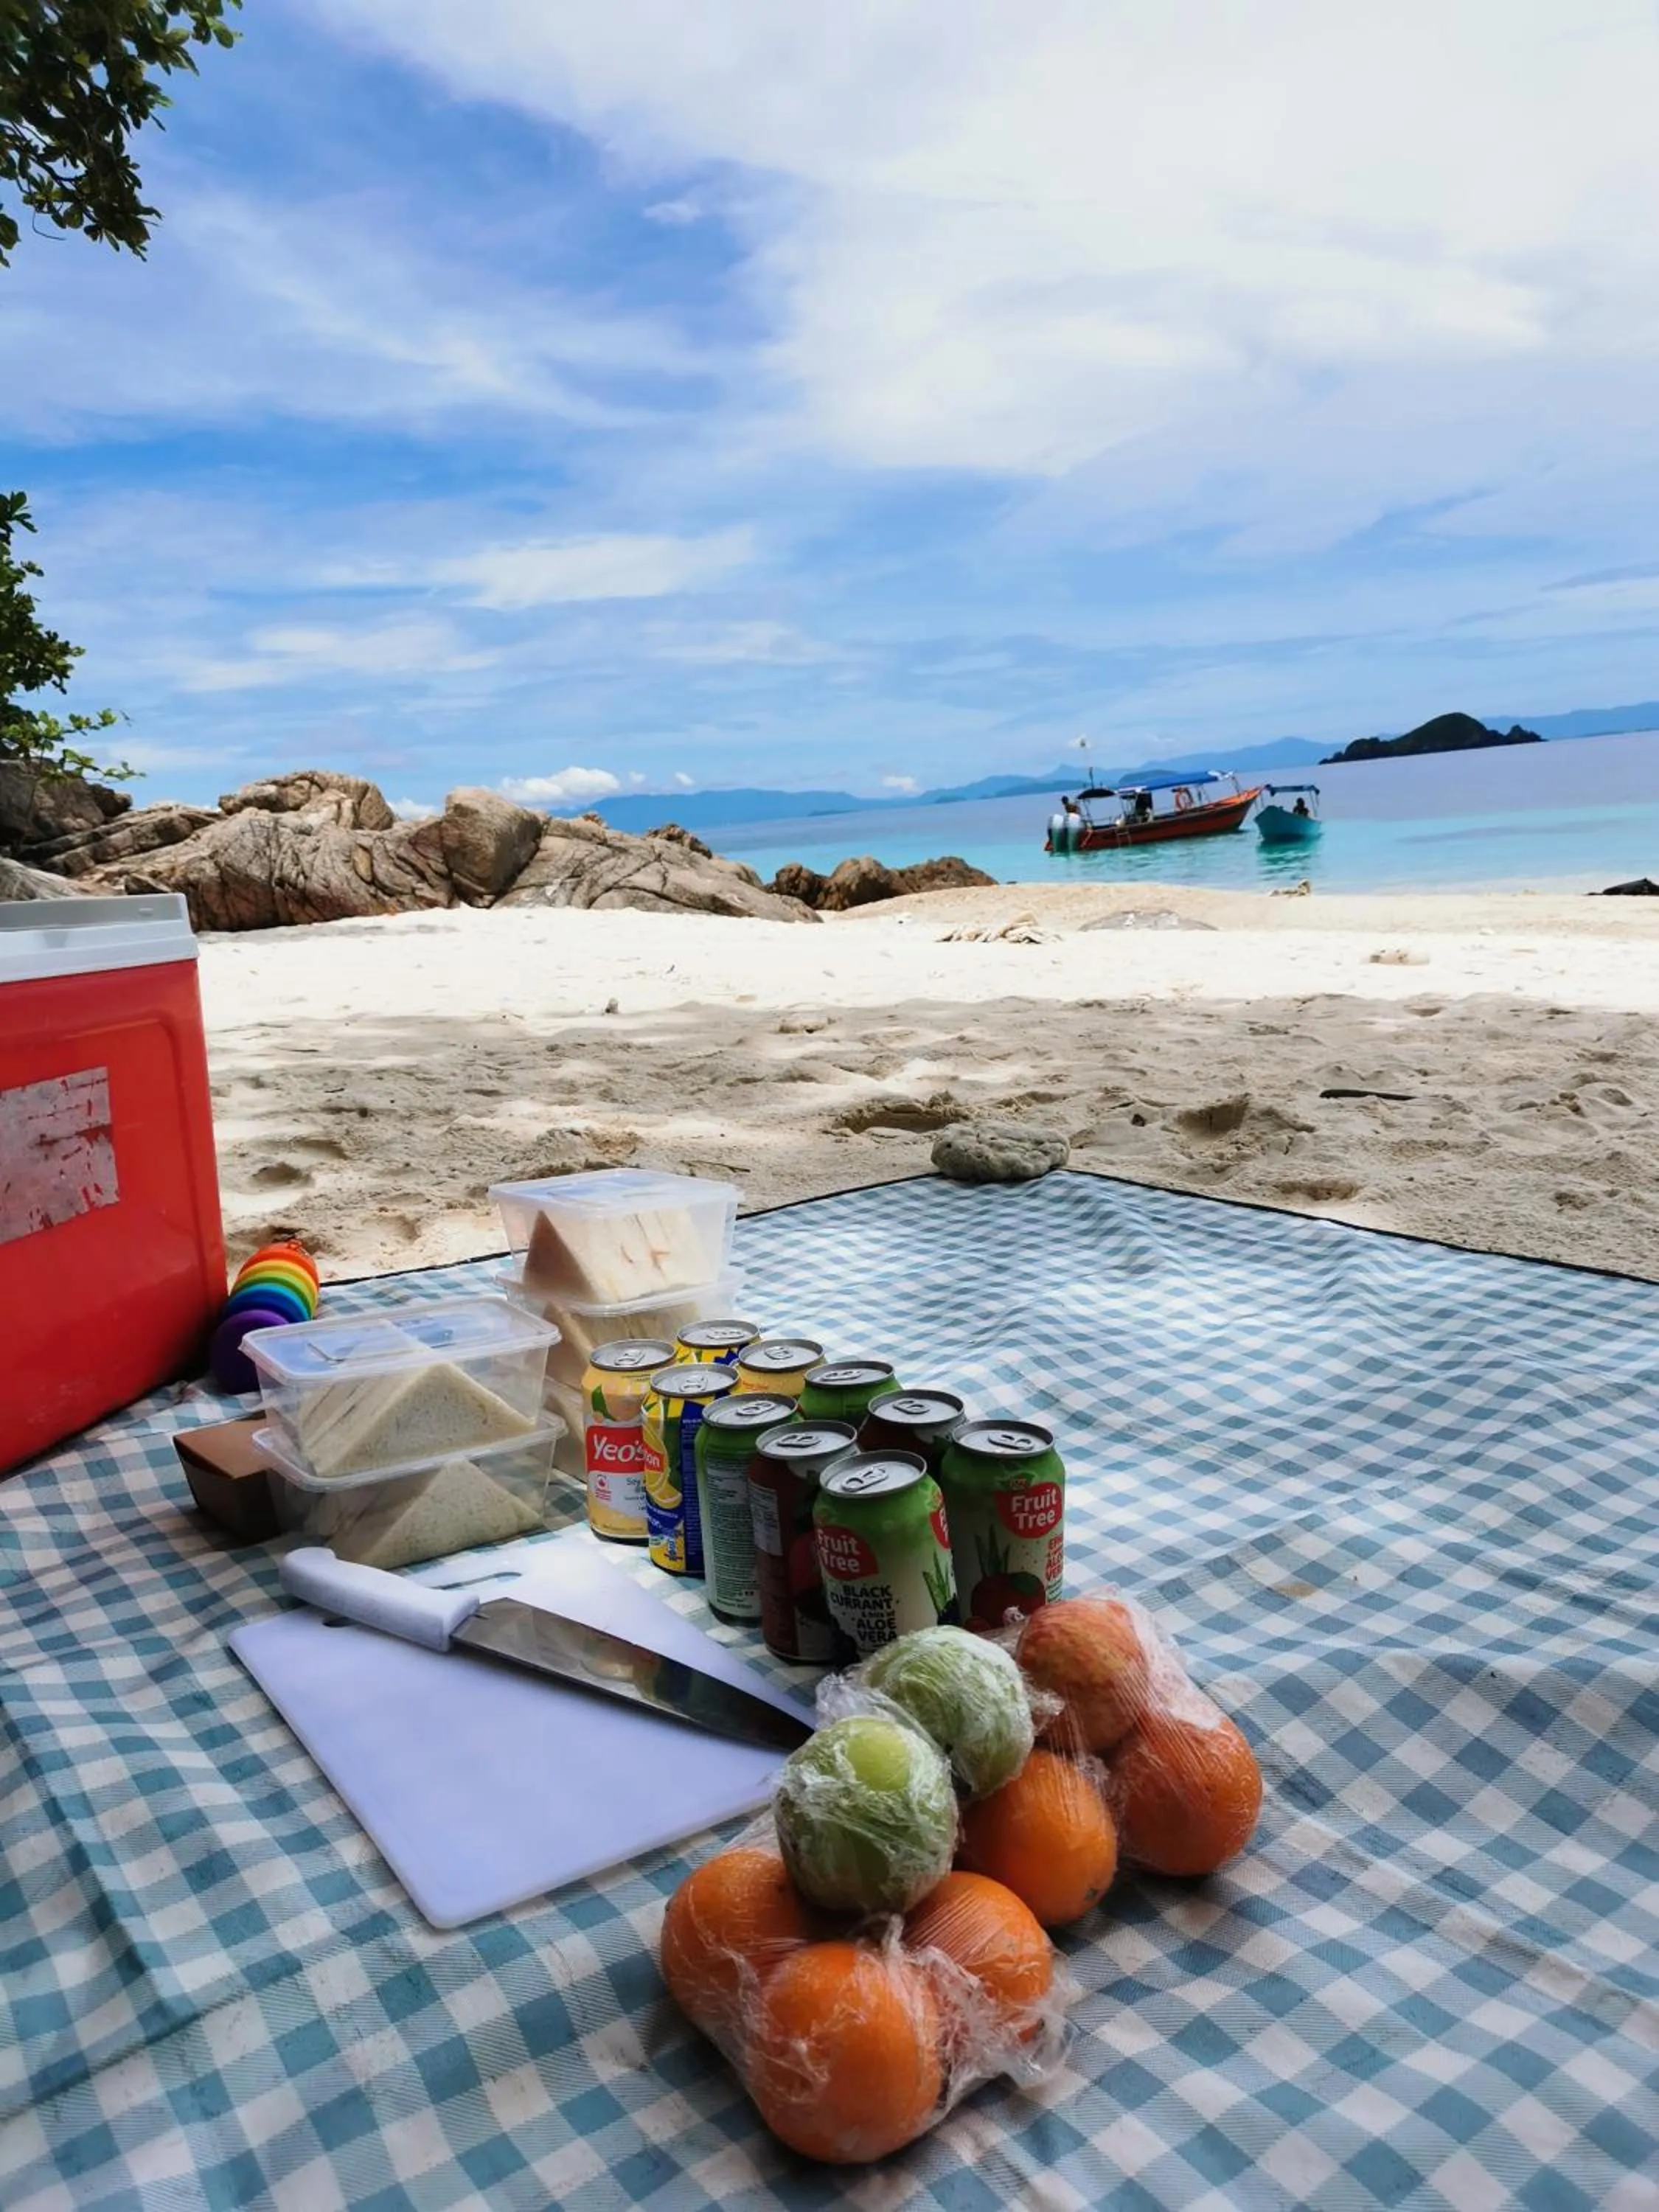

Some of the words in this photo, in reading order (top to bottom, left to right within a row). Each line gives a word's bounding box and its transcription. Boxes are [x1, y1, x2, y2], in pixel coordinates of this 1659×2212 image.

[1012, 1489, 1057, 1512] Fruit
[1015, 1509, 1055, 1530] Tree
[817, 1528, 860, 1555] Fruit
[820, 1547, 860, 1573] Tree
[830, 1591, 894, 1610] CURRANT
[844, 1585, 893, 1598] BLACK
[857, 1618, 897, 1630] ALOE
[858, 1630, 897, 1644] VERA
